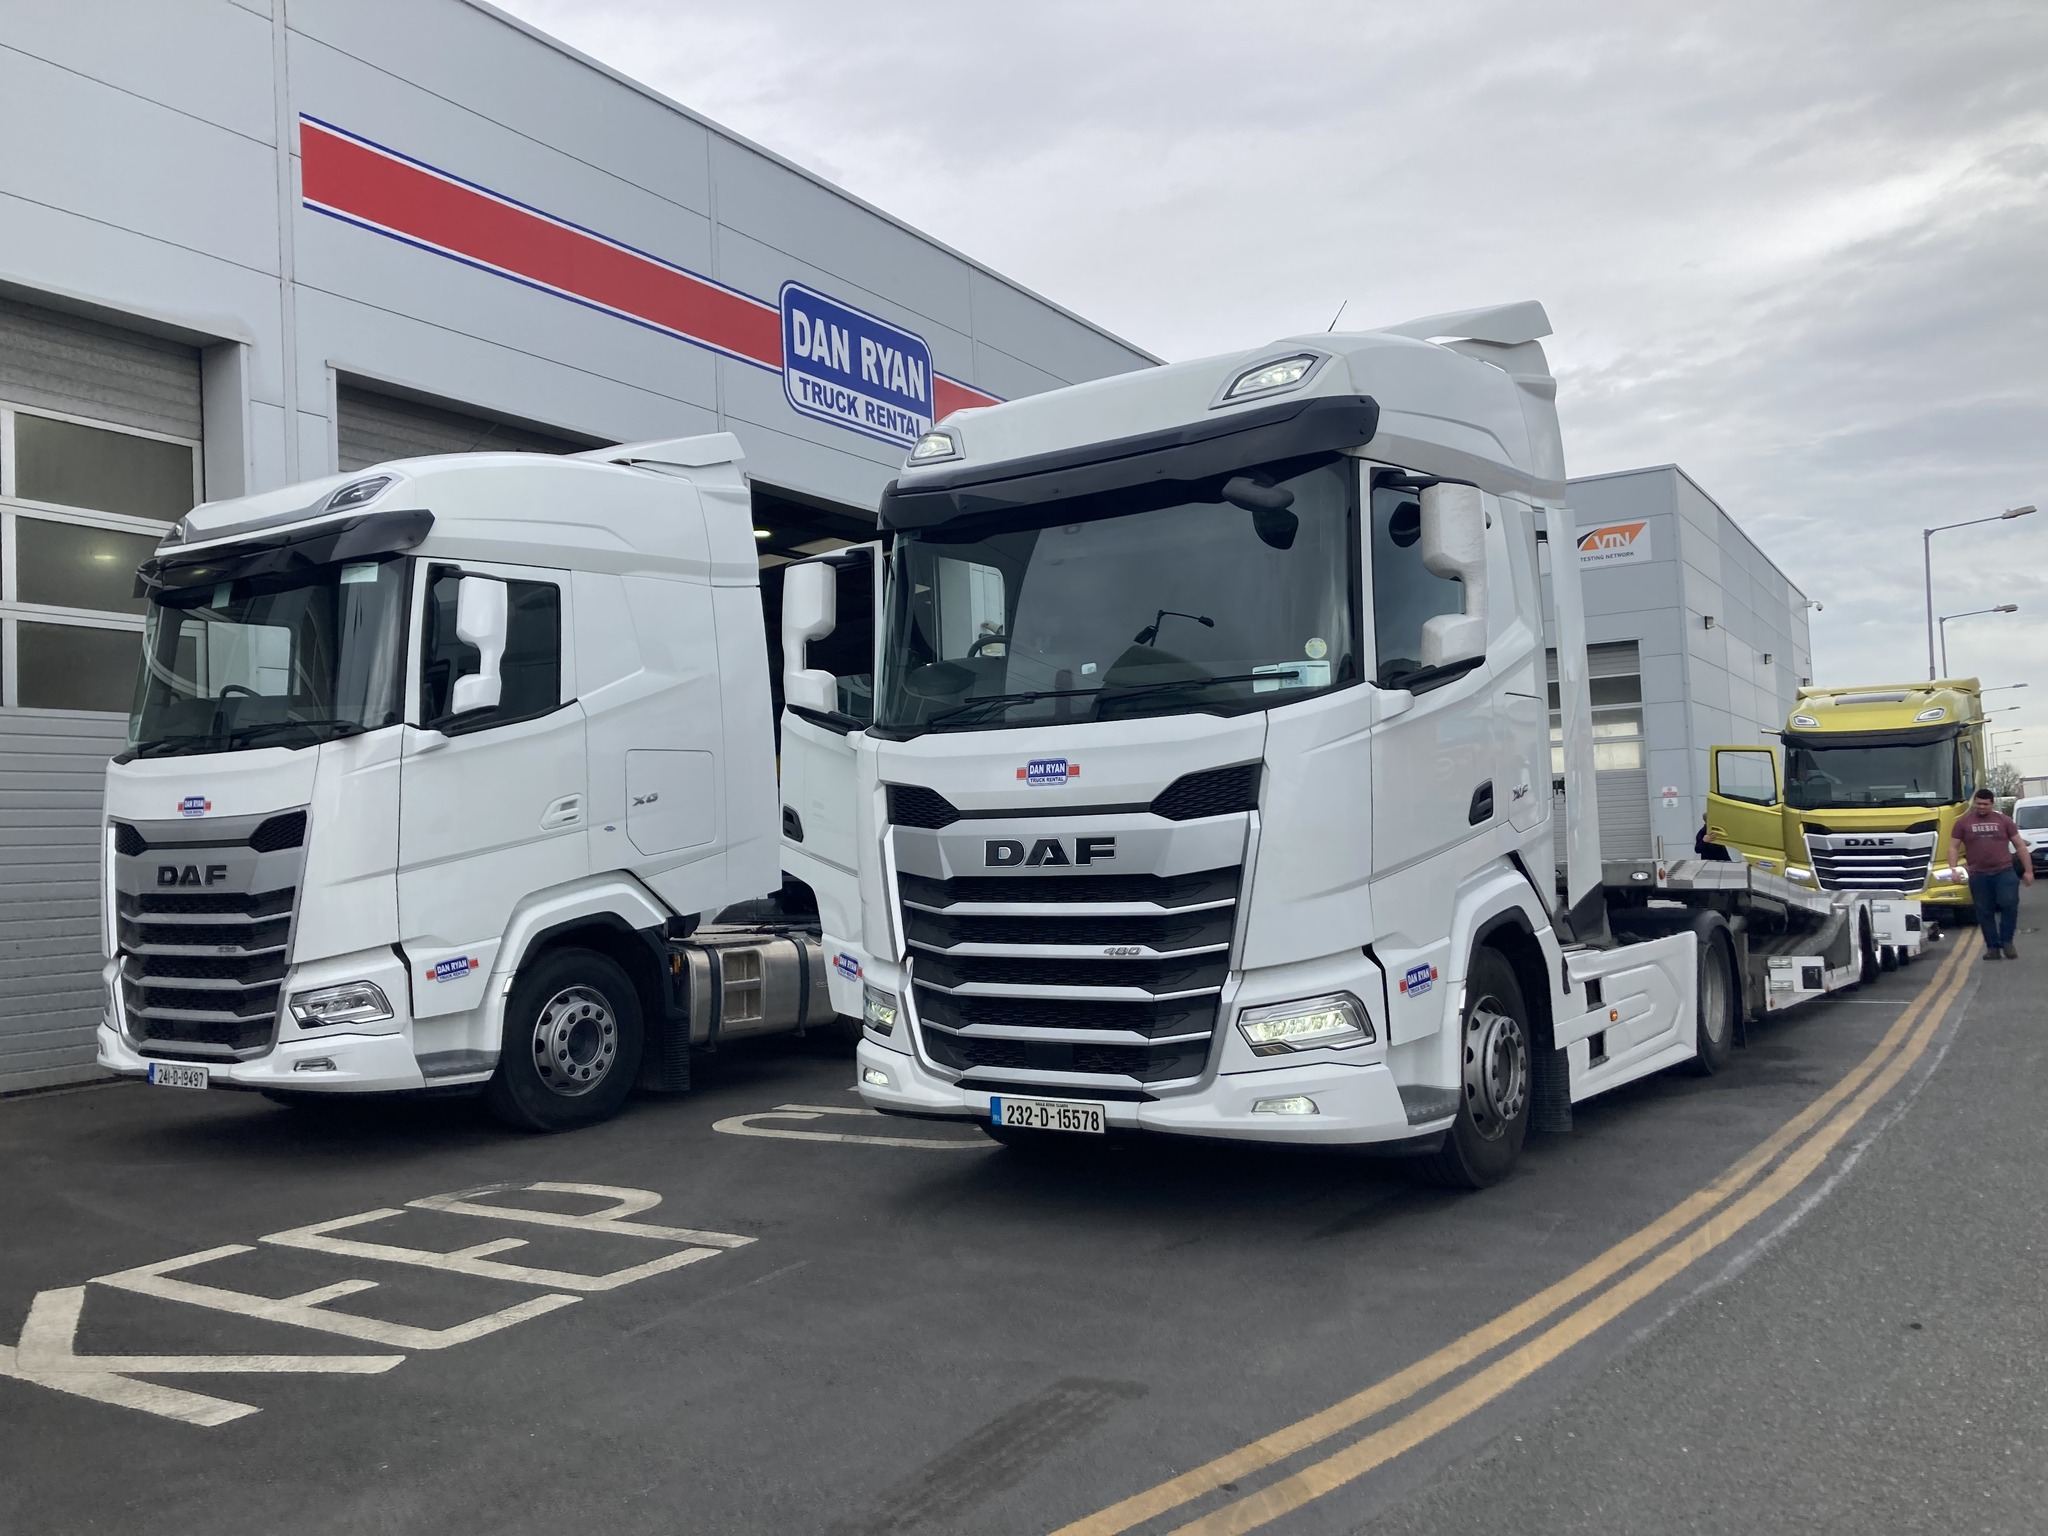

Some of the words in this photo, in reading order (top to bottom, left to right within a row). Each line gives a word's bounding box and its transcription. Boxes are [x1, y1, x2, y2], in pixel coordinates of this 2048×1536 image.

[792, 308, 850, 374] DAN
[860, 336, 925, 403] RYAN
[799, 375, 859, 418] TRUCK
[865, 400, 922, 439] RENTAL
[1580, 554, 1604, 562] TESTING
[1605, 551, 1635, 560] NETWORK
[1029, 764, 1044, 775] DAN
[1046, 763, 1065, 773] RYAN
[984, 837, 1116, 867] DAF
[1844, 838, 1893, 847] DAF
[157, 864, 227, 886] DAF
[1104, 947, 1142, 956] 480
[437, 964, 450, 974] DAN
[450, 959, 467, 971] RYAN
[1007, 1104, 1100, 1132] 232-D-15578
[0, 1181, 758, 1426] KEEP
